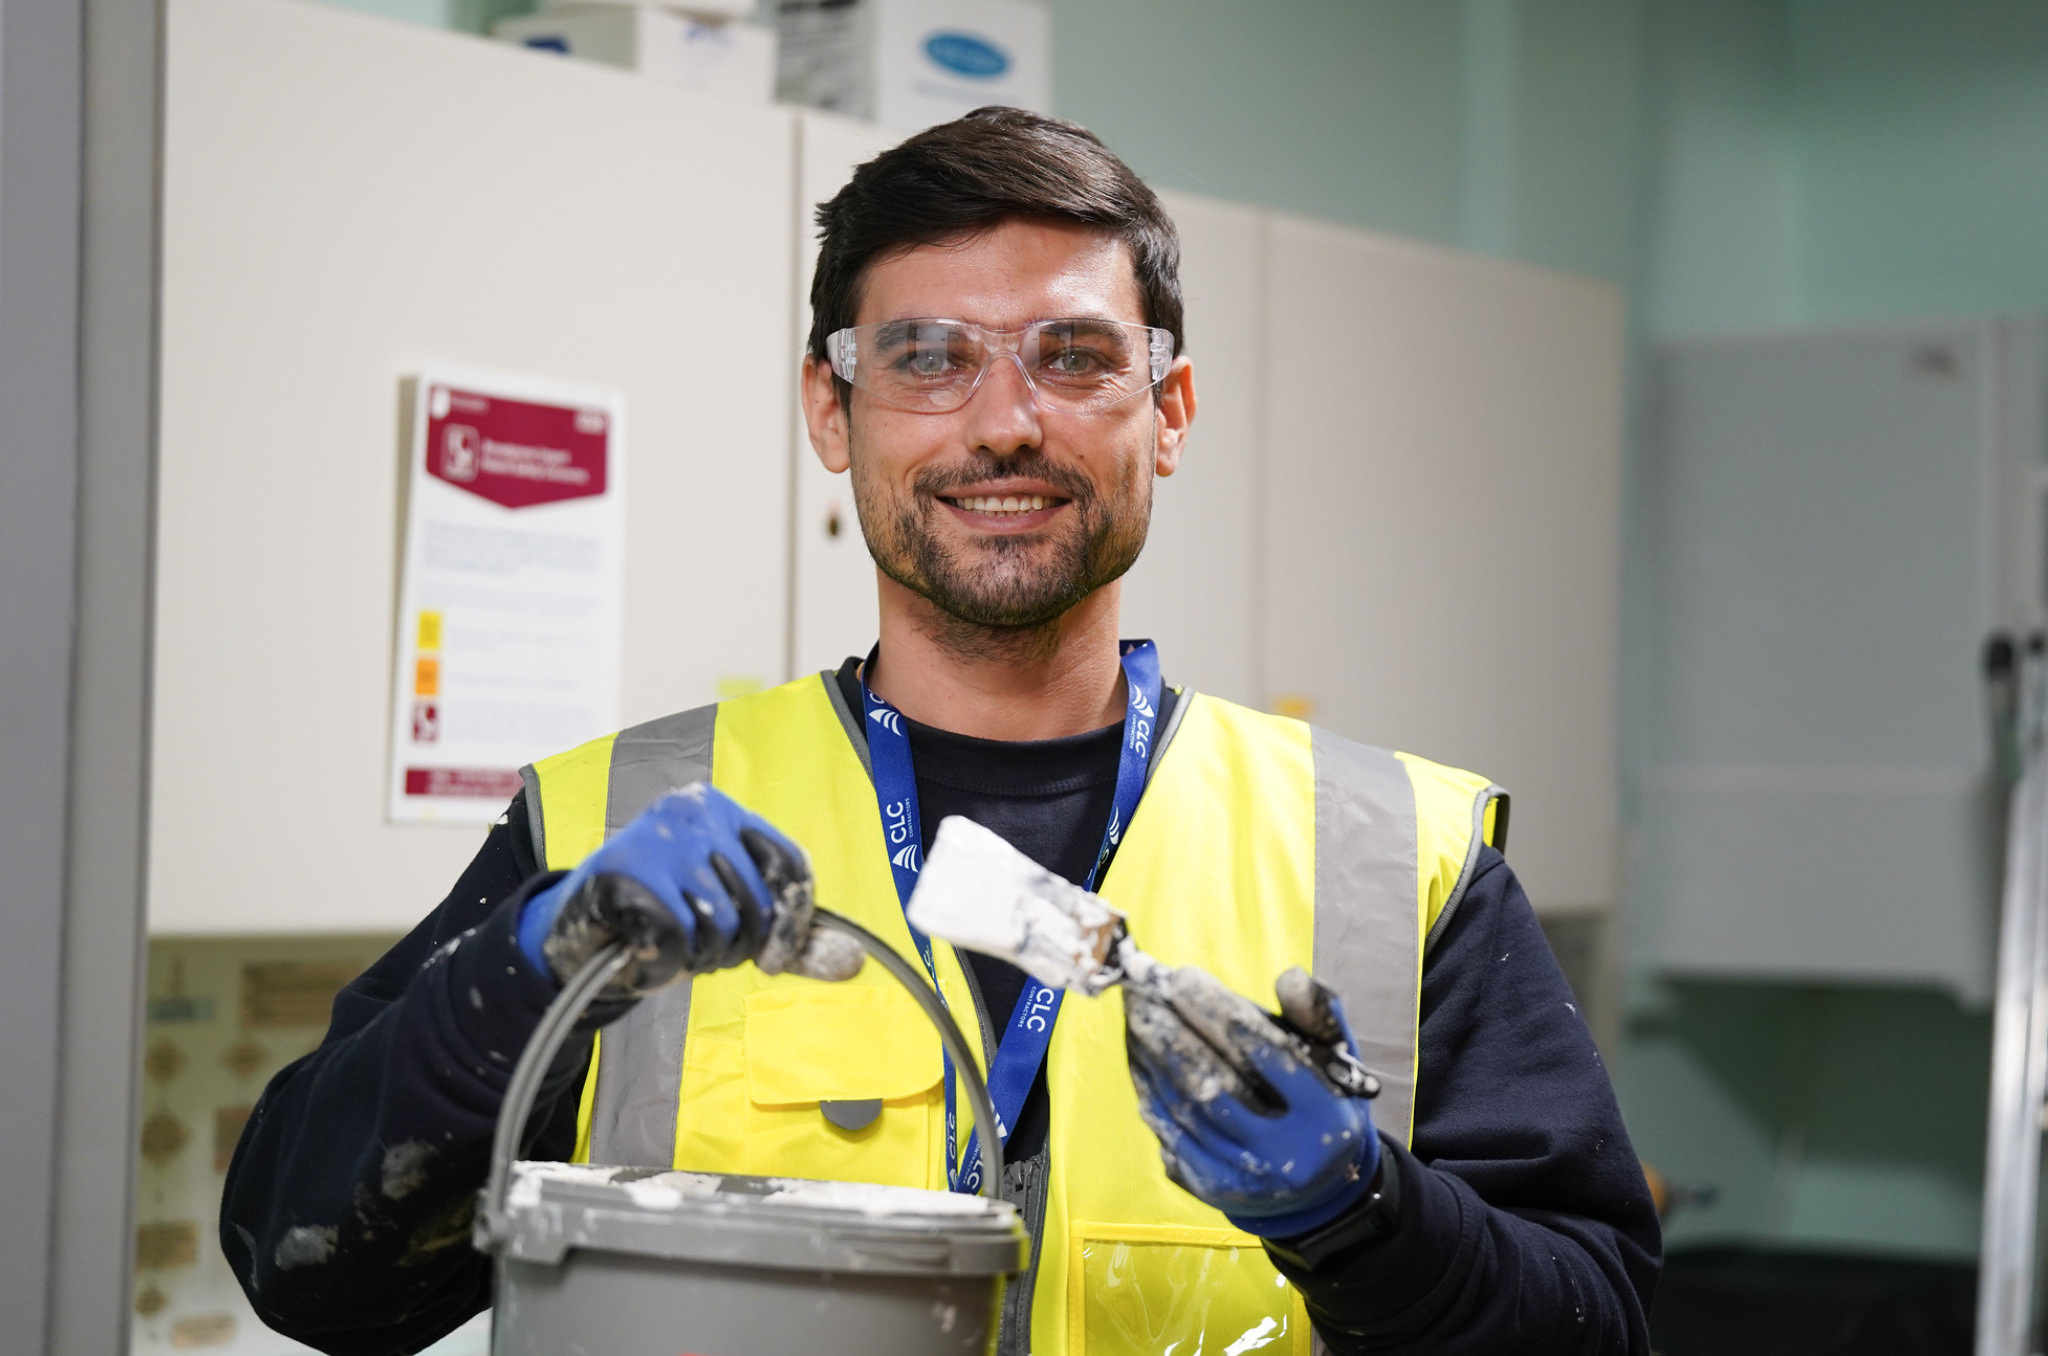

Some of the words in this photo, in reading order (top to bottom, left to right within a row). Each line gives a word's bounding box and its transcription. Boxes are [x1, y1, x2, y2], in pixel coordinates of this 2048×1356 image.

[1135, 719, 1150, 759] CLC
[886, 801, 907, 844] CLC
[1017, 985, 1037, 1028] CONTRACTORS
[1026, 987, 1055, 1033] CLC
[962, 1140, 981, 1184] ONTRACTORS
[966, 1150, 986, 1190] LC
